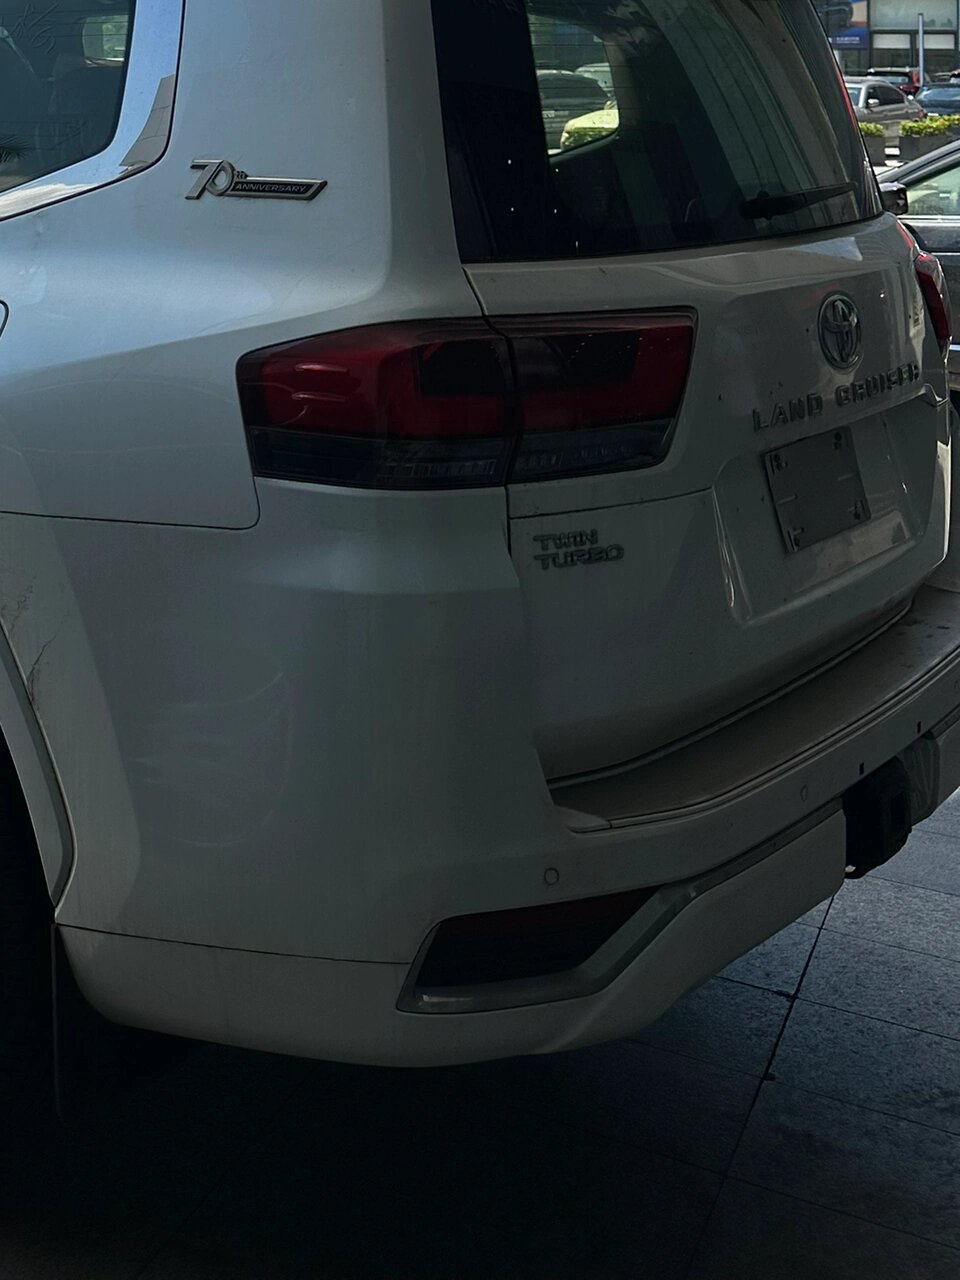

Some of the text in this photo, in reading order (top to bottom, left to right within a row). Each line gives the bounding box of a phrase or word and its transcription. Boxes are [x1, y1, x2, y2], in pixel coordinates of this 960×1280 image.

[185, 159, 237, 200] 70
[234, 183, 307, 194] ANNIVERSARY
[752, 363, 920, 432] LAND CRUISER
[533, 528, 598, 551] TWIN
[533, 544, 625, 570] TURBO
